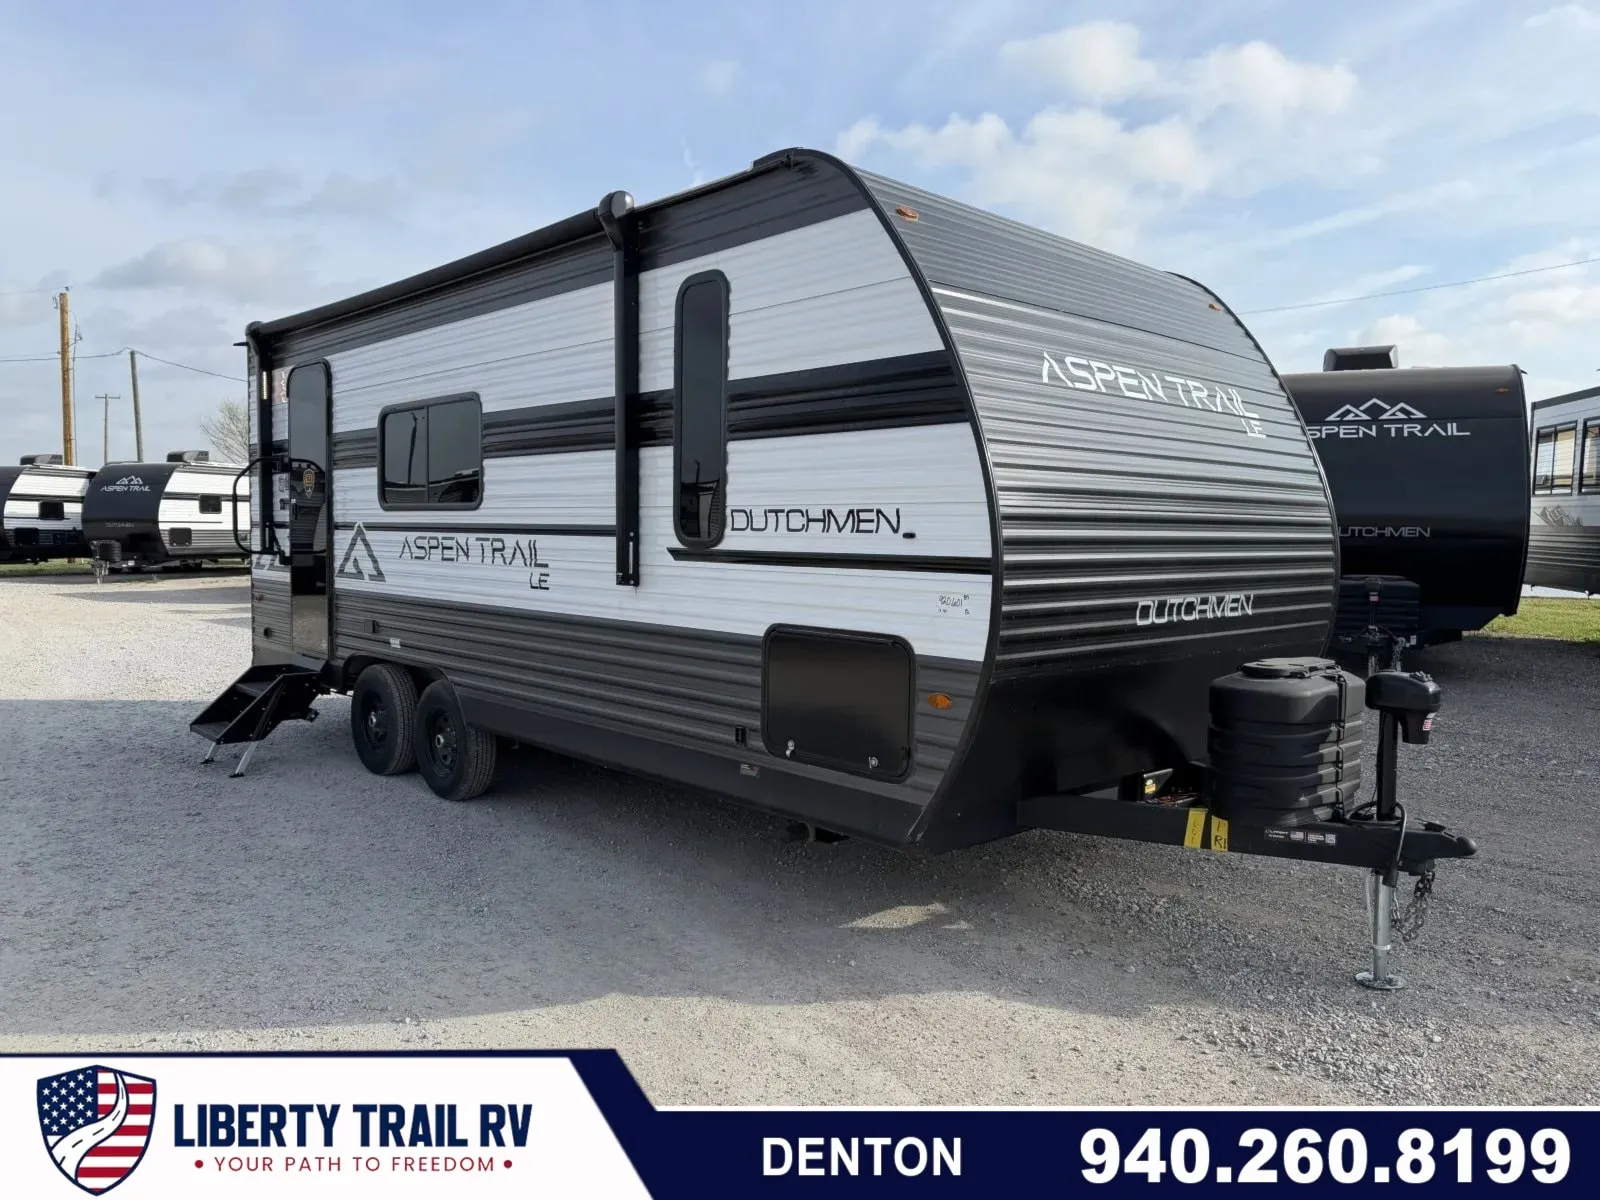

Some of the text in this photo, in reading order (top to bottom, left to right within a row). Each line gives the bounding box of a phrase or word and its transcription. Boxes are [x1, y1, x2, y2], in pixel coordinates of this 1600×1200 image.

[1042, 351, 1260, 418] ASPEN TRAIL
[1241, 416, 1267, 438] LE
[1306, 422, 1471, 439] SPEN TRAIL
[731, 508, 901, 534] DUTCHMEN
[1337, 526, 1431, 538] UTCHMEN
[399, 535, 549, 568] ASPEN TRAIL
[529, 572, 550, 590] LE
[1136, 593, 1254, 626] DUTCHMEN
